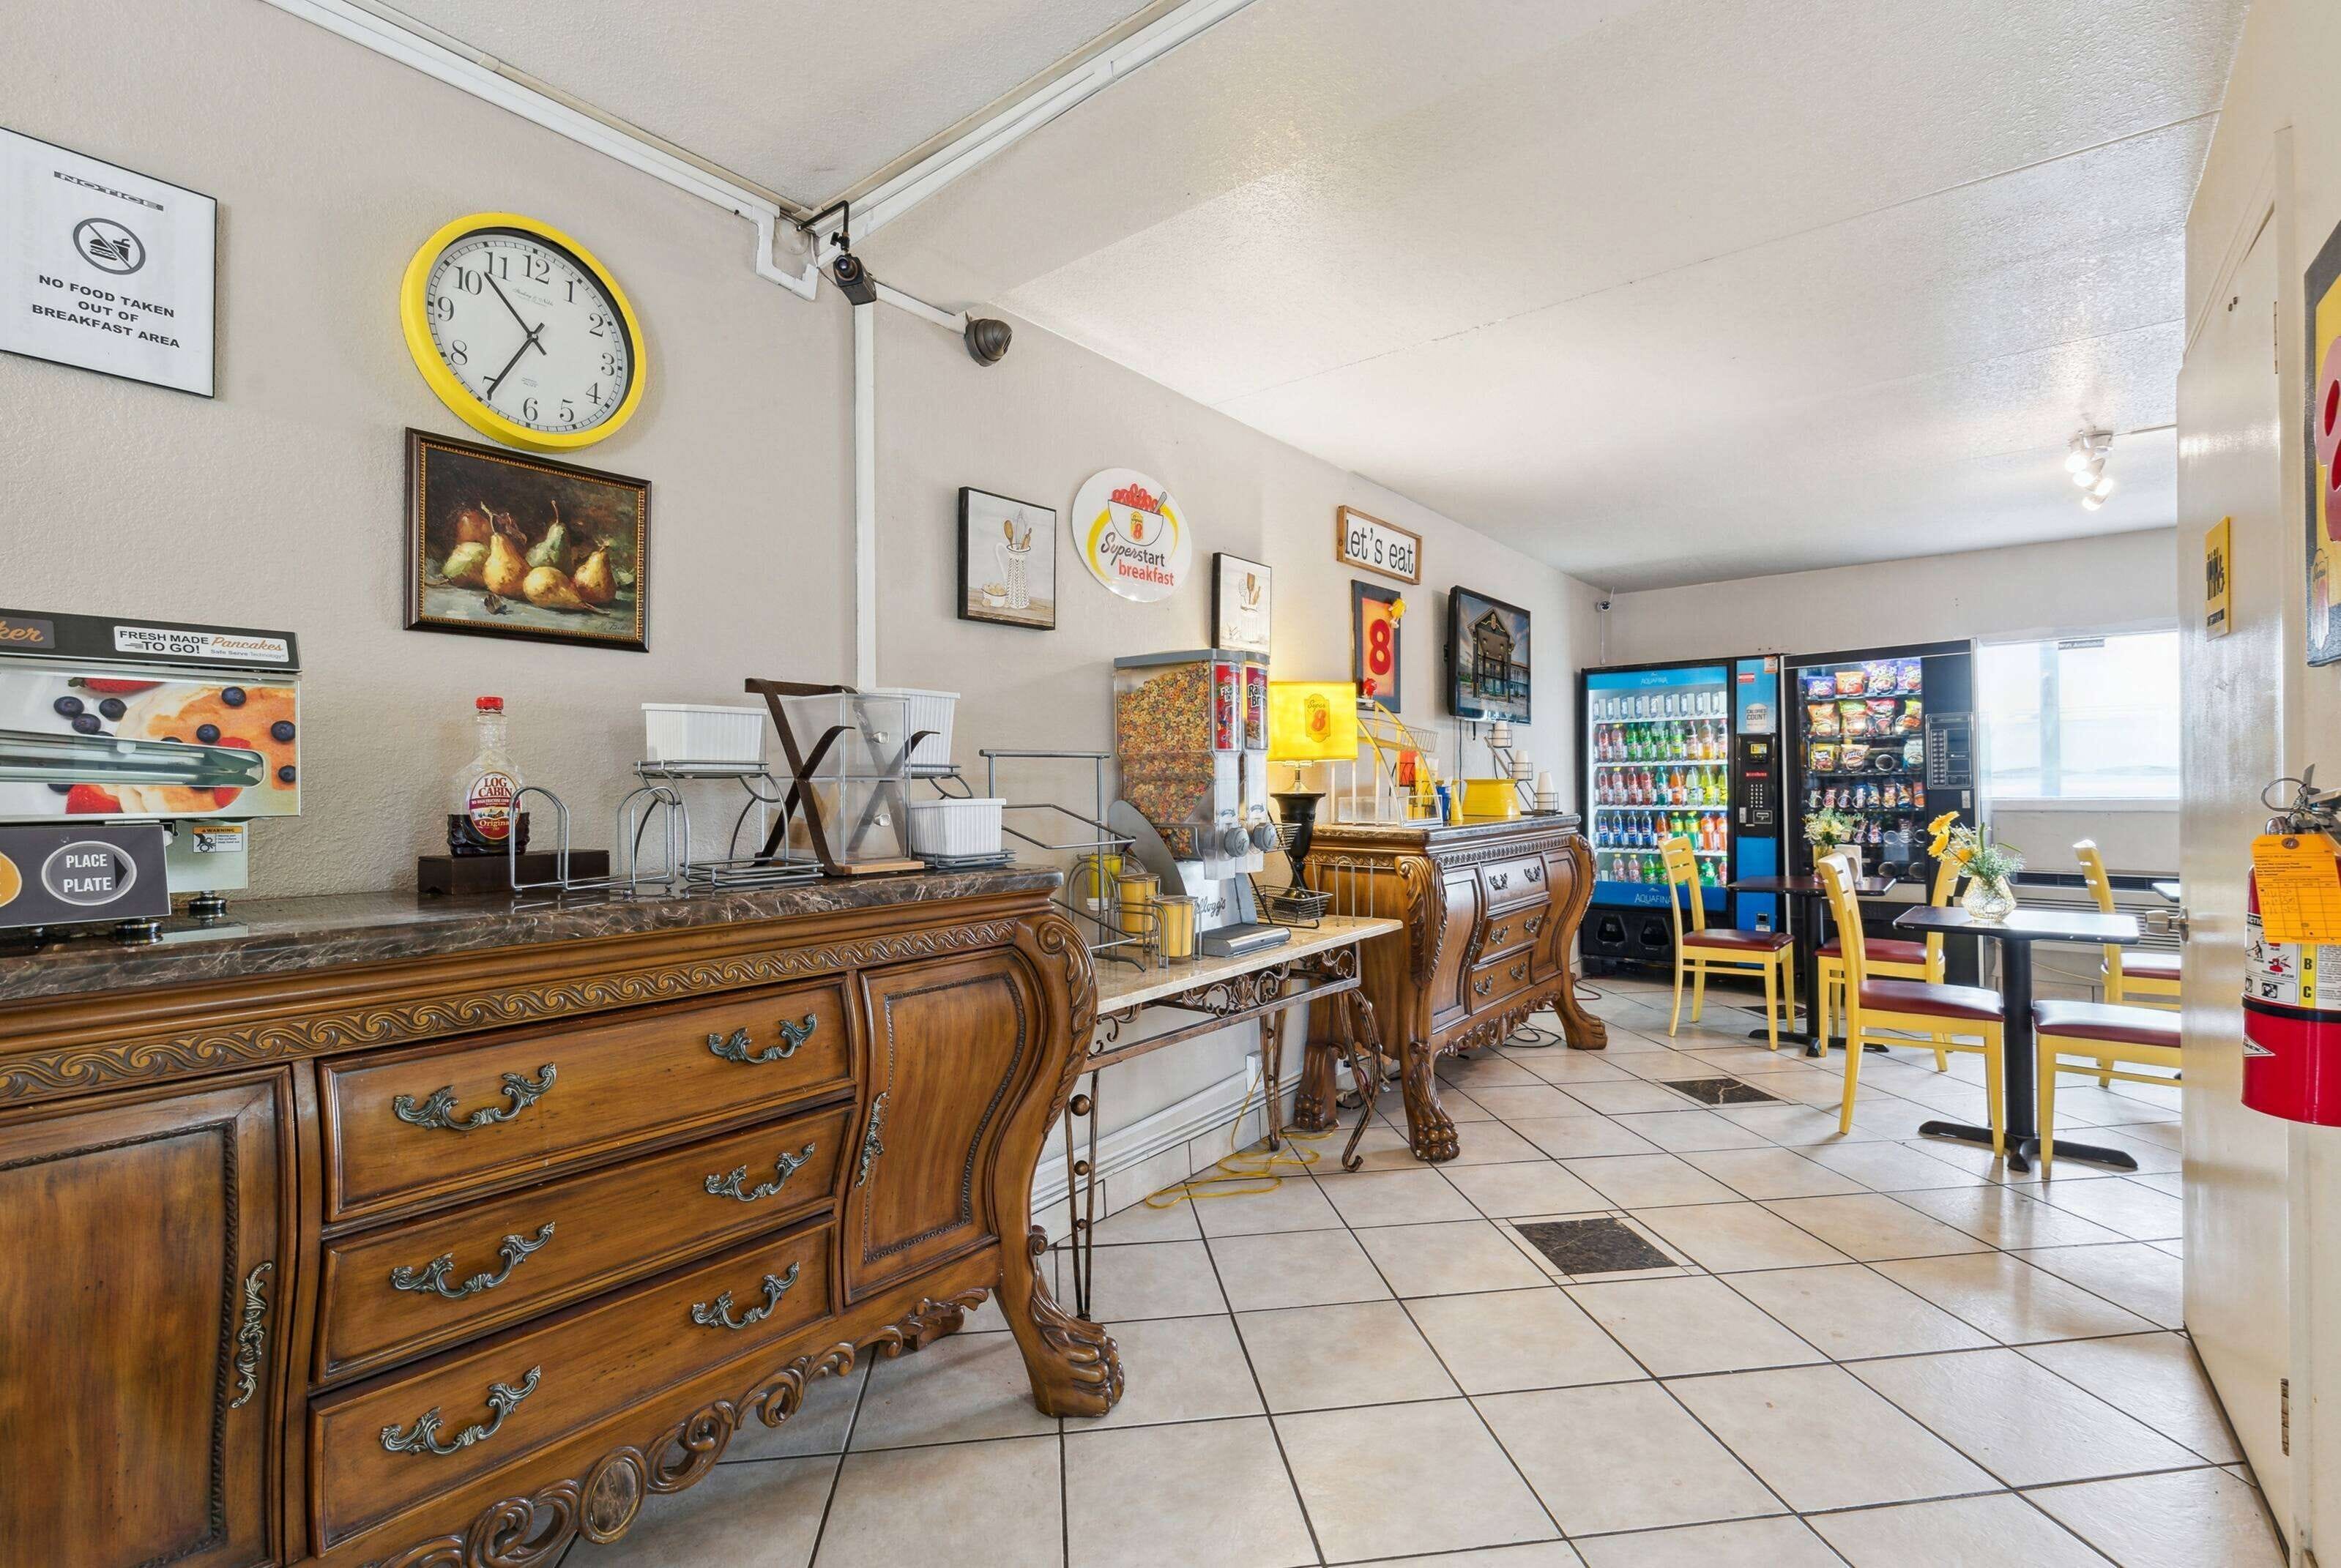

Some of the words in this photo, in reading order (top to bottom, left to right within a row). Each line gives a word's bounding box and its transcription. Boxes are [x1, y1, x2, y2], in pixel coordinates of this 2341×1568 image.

[60, 173, 159, 210] NOTICE
[485, 251, 511, 282] 11
[522, 255, 551, 285] 12
[453, 265, 483, 296] 10
[564, 280, 577, 305] 1
[39, 275, 64, 288] NO
[70, 283, 115, 302] FOOD
[121, 296, 175, 318] TAKEN
[438, 296, 455, 321] 9
[78, 301, 113, 316] OUT
[119, 311, 138, 323] OF
[32, 304, 133, 336] BREAKFAST
[138, 331, 180, 348] AREA
[589, 313, 604, 337] 2
[450, 340, 468, 366] 8
[601, 352, 615, 376] 3
[586, 382, 602, 405] 4
[523, 397, 538, 422] 6
[559, 399, 575, 422] 5
[1101, 531, 1165, 567] Superstart
[1346, 520, 1383, 564] let's
[1388, 543, 1414, 575] eat
[1119, 559, 1175, 586] breakfast
[119, 630, 166, 641] FRESH
[171, 634, 209, 645] MADE
[142, 641, 165, 652] TO
[170, 643, 200, 654] GO!
[211, 636, 283, 652] Pancakes
[1369, 619, 1391, 676] 8
[1311, 709, 1327, 732] 8
[1746, 713, 1767, 721] COUNT
[479, 788, 512, 796] CABIN
[484, 777, 507, 787] LOG
[66, 854, 108, 868] PLACE
[64, 877, 112, 893] PLATE
[2304, 957, 2312, 970] B
[2303, 985, 2312, 998] C
